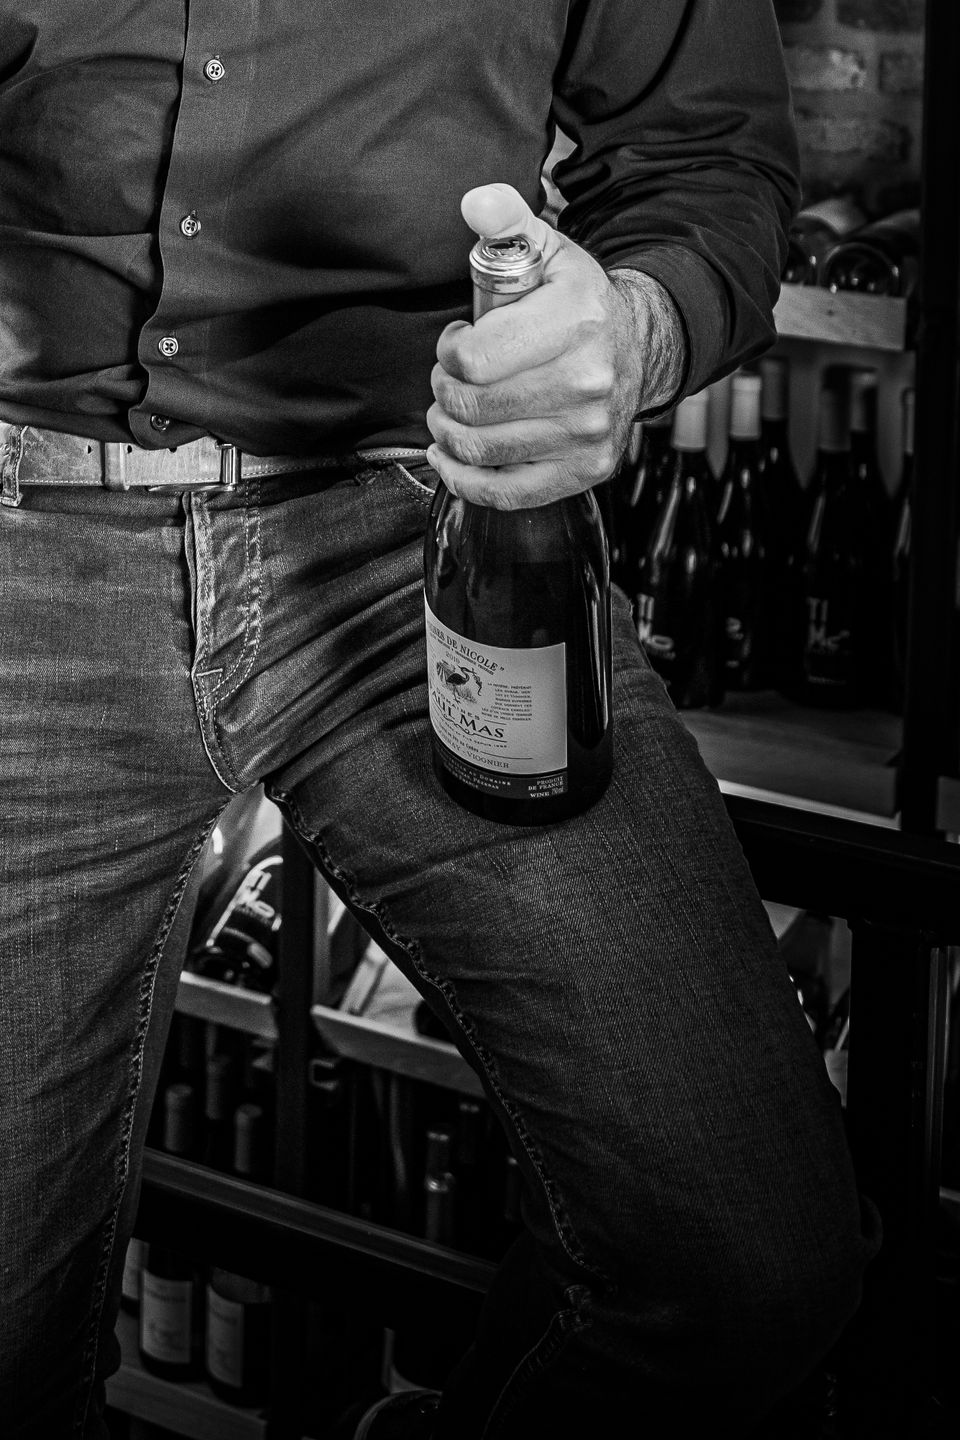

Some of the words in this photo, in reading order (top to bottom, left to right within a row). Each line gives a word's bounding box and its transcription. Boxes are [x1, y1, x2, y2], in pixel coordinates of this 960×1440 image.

[446, 635, 458, 649] DE
[460, 643, 499, 672] NICOLE
[459, 714, 505, 738] MAS
[539, 781, 563, 790] FRANCE
